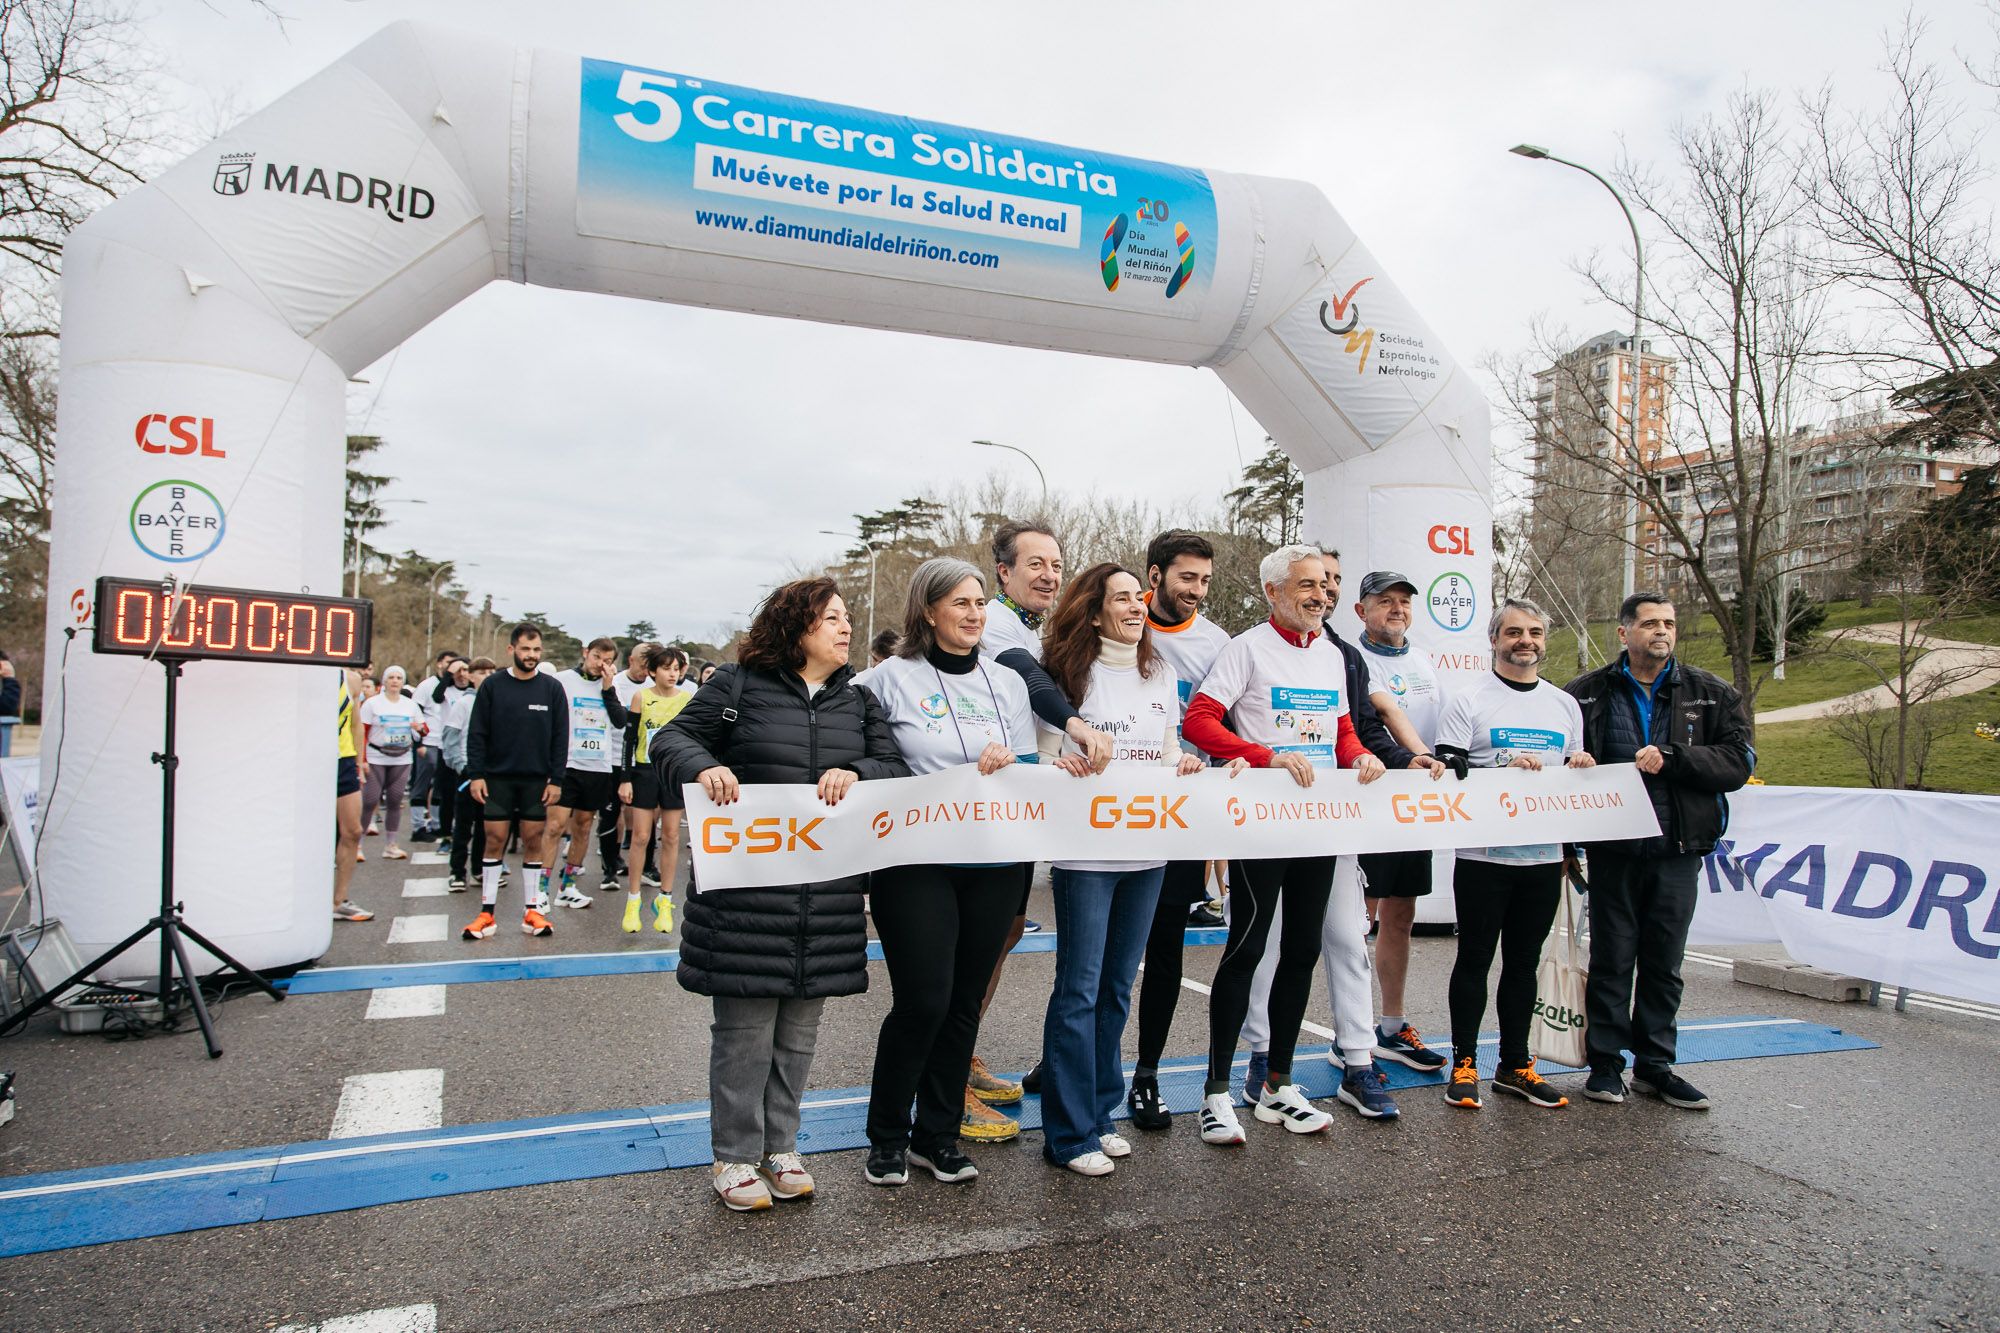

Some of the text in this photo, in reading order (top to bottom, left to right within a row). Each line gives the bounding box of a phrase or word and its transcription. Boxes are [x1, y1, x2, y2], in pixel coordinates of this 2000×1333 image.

[613, 69, 1117, 197] 5ª Carrera Solidaria
[264, 163, 434, 223] MADRID
[712, 155, 1067, 233] Muévete por la Salud Renal
[1135, 196, 1169, 222] 20
[695, 209, 999, 268] www.diamundialdelriñon.com
[1129, 230, 1146, 241] Día
[1127, 244, 1168, 259] Mundial
[1125, 258, 1172, 273] del Riñón
[1124, 271, 1168, 284] 12 marzo 2026
[1379, 333, 1424, 348] Sociedad
[1379, 349, 1440, 366] Española de
[135, 413, 226, 459] CSL
[138, 513, 217, 530] BAYER
[170, 487, 185, 556] BAYER
[1427, 525, 1475, 556] CSL
[1432, 596, 1472, 608] BAYER
[1450, 577, 1458, 627] BAYER
[117, 590, 354, 657] 00:00:00
[581, 740, 600, 750] 401
[1137, 739, 1152, 747] algo
[1112, 749, 1162, 761] UDRENA
[702, 793, 1623, 854] GSK DIAVERUM GSK DIAVERUM GSK DIAVERUM
